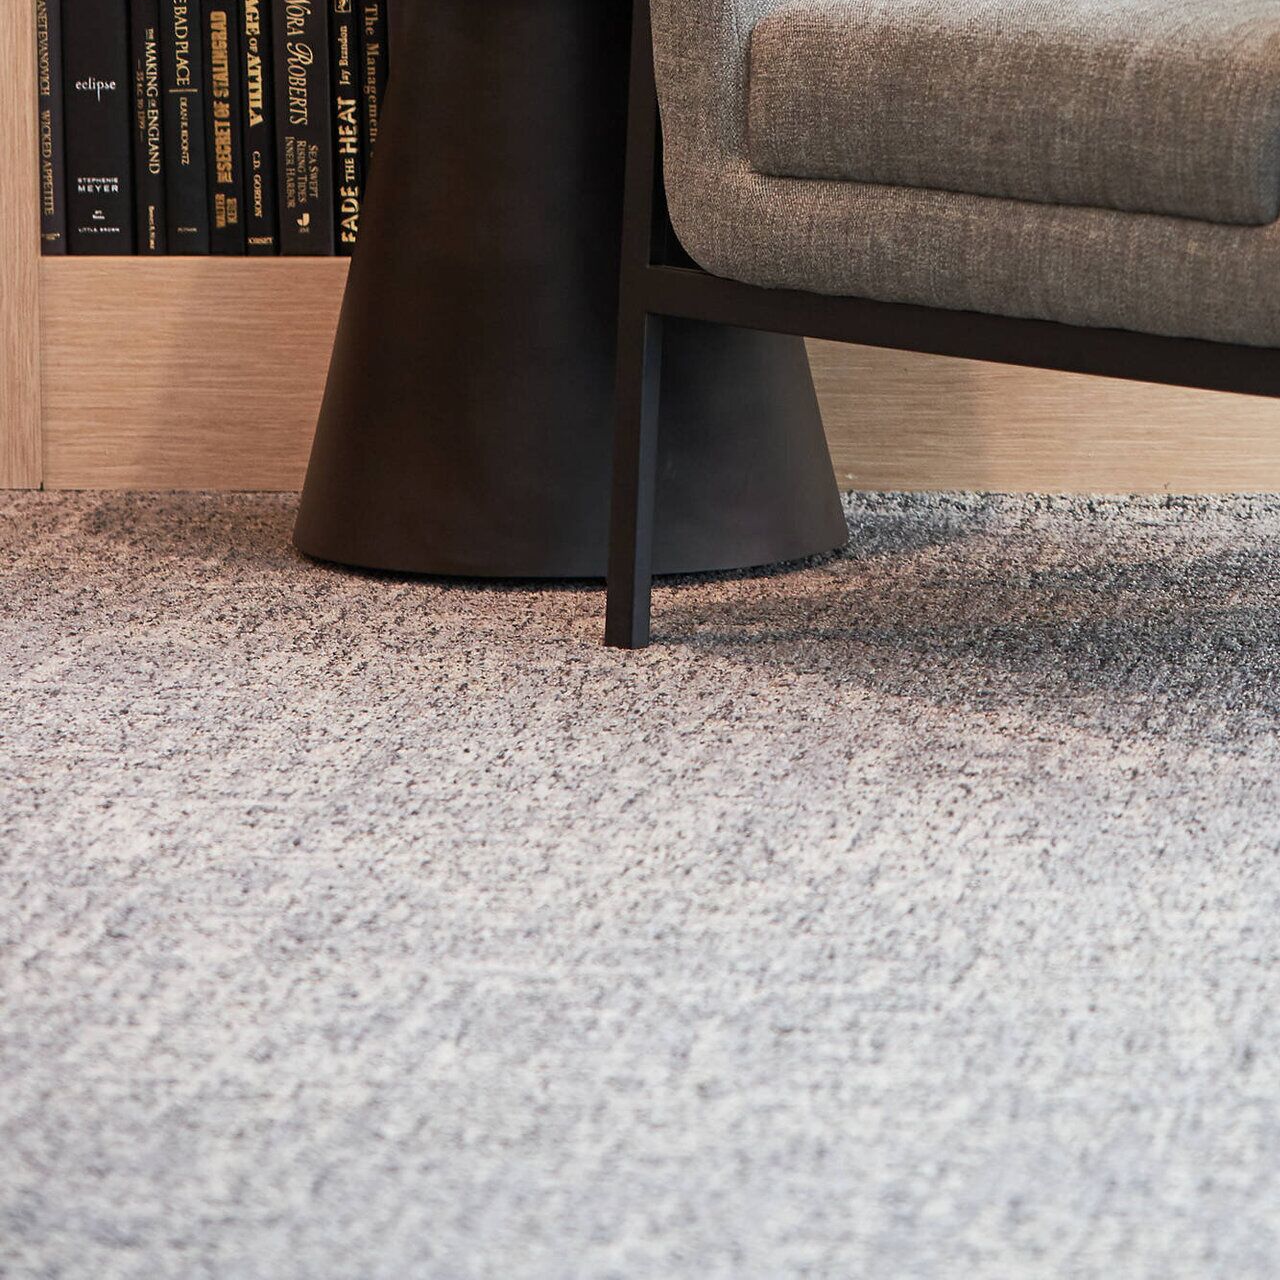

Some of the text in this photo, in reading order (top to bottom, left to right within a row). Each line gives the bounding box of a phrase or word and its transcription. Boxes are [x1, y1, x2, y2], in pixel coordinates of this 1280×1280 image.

[173, 7, 187, 39] BAD
[174, 41, 190, 86] PLACE
[76, 78, 115, 102] eclipse
[286, 42, 313, 125] ROBERTS
